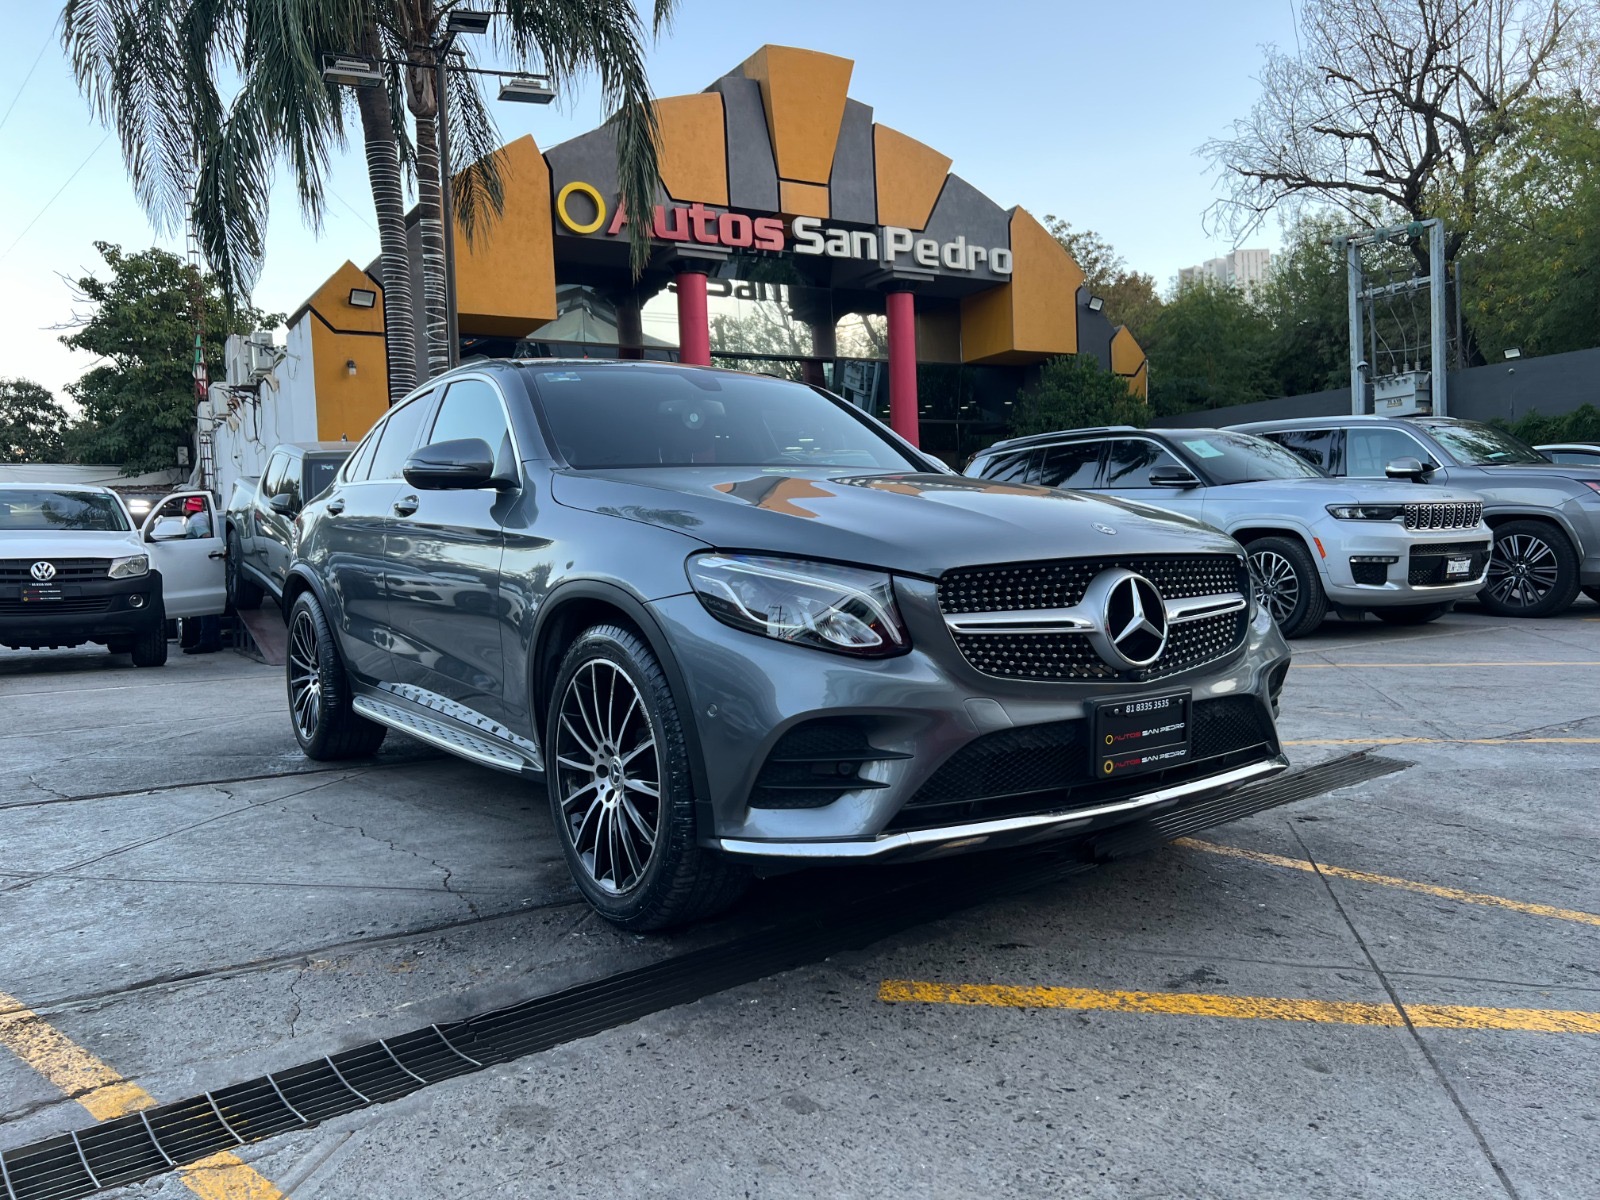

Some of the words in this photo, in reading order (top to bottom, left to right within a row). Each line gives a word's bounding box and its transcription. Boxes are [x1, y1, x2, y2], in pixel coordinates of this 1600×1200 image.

[608, 203, 784, 251] Autos
[792, 216, 878, 260] San
[883, 226, 1013, 275] Pedro
[1125, 704, 1135, 713] 81
[1136, 702, 1152, 711] 8335
[1153, 699, 1169, 709] 3535
[1114, 732, 1141, 740] AUTOS
[1141, 728, 1159, 737] SAN
[1160, 722, 1185, 732] PEDRO
[1115, 759, 1141, 768] AUTOS
[1141, 755, 1159, 763] SAN
